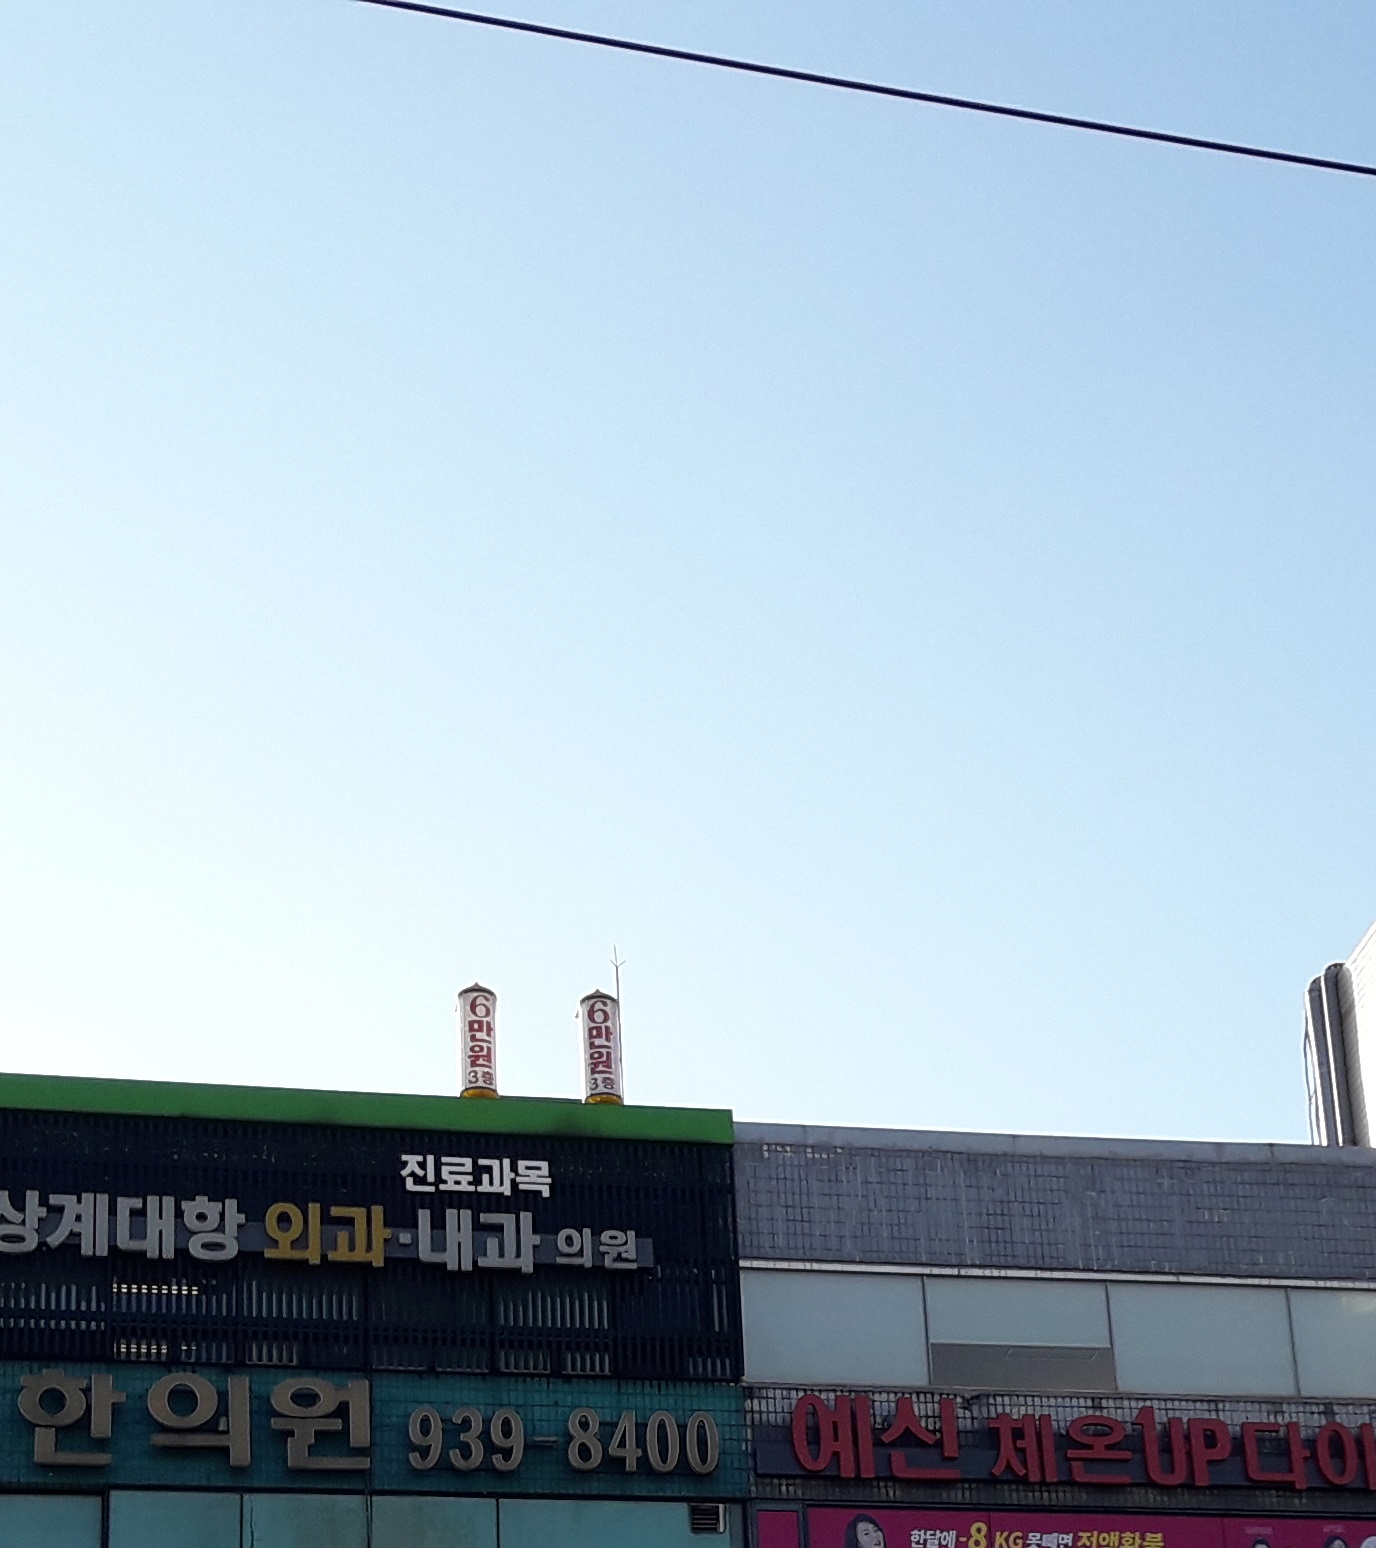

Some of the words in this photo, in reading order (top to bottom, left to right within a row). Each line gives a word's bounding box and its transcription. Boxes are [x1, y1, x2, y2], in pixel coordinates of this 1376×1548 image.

[464, 992, 498, 1069] 6만원
[583, 998, 617, 1073] 6만원
[398, 1152, 554, 1200] 진료과목
[555, 1226, 640, 1272] 의원
[406, 1404, 723, 1478] 939-8400
[791, 1393, 962, 1481] 예신
